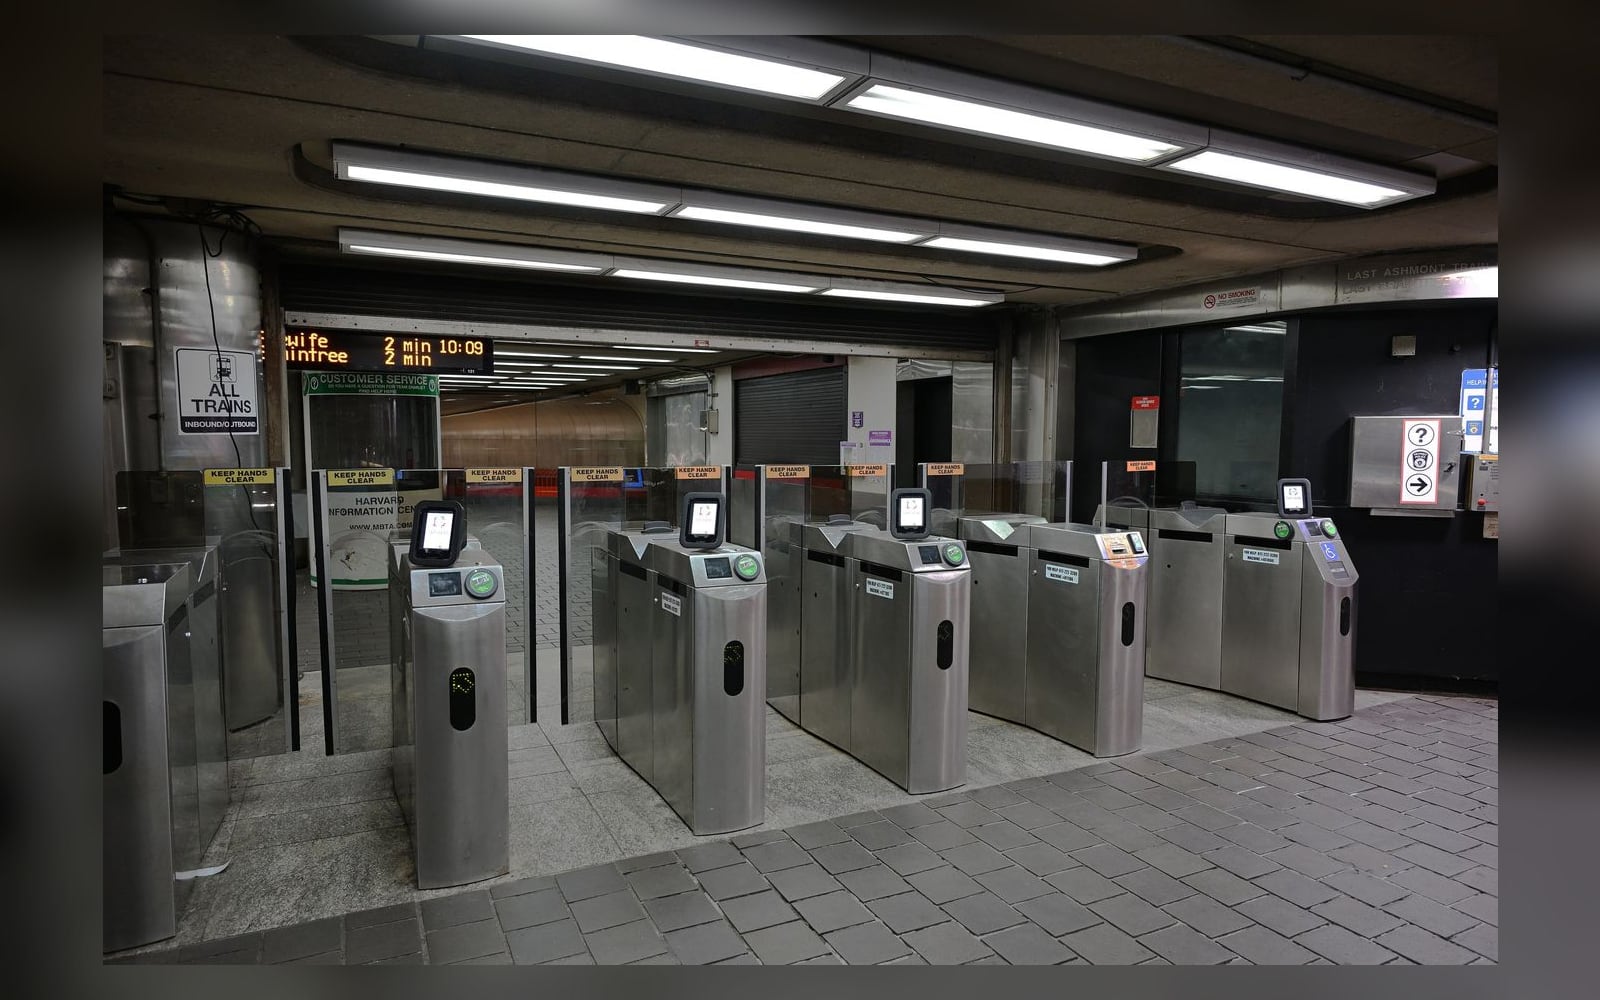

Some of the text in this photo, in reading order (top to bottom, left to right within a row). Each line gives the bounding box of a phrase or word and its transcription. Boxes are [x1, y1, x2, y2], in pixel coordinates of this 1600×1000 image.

[1347, 269, 1377, 281] LAST
[1384, 264, 1446, 277] ASHMONT
[1228, 289, 1255, 299] SMOKING
[384, 337, 395, 351] 2
[403, 339, 431, 353] min
[440, 339, 484, 355] 10:09
[385, 351, 395, 365] 2
[403, 353, 432, 366] min
[320, 373, 428, 386] CUSTOMER SERVICE
[209, 383, 240, 397] ALL
[191, 399, 252, 413] TRAINS
[355, 496, 404, 505] HARVARD
[328, 505, 416, 516] NFORMATION CEN
